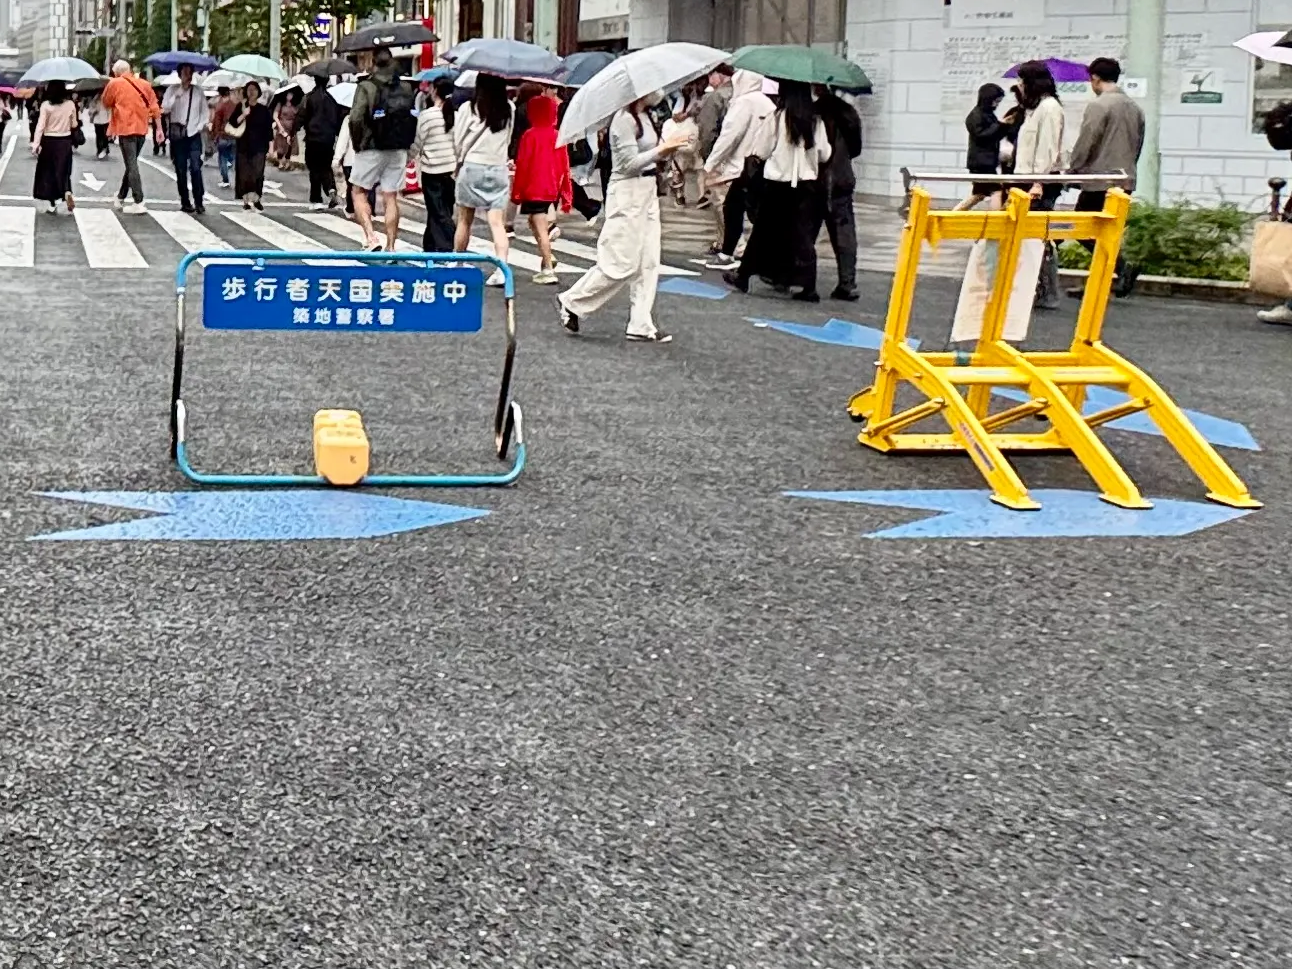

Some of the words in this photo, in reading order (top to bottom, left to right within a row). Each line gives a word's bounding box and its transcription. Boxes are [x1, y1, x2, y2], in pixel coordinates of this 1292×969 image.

[221, 277, 466, 304] 歩行者天国実施中
[293, 307, 395, 325] 築地警察署
